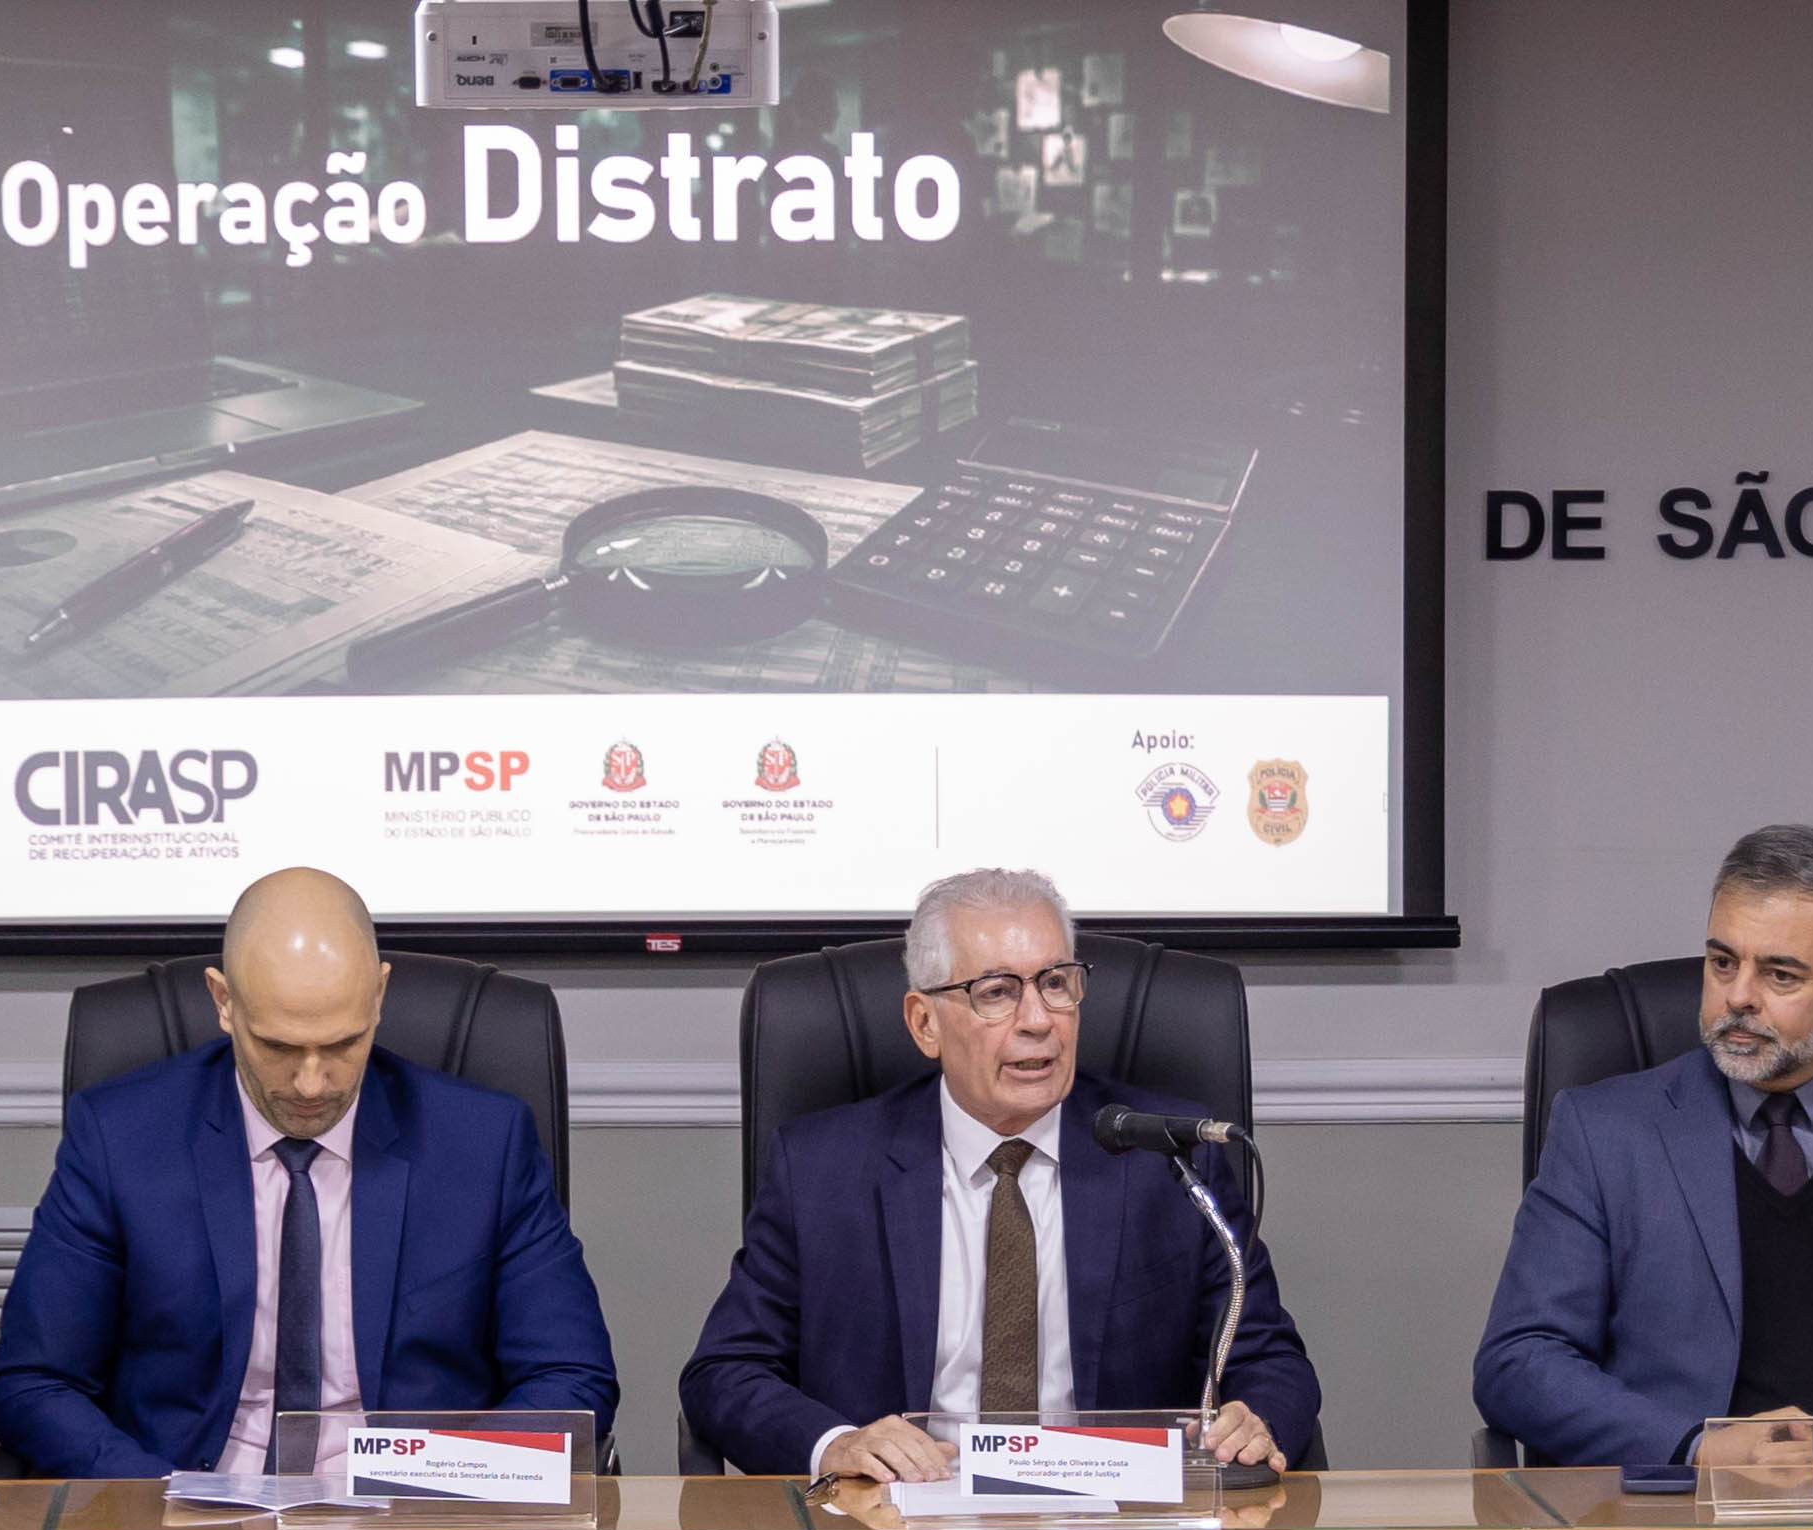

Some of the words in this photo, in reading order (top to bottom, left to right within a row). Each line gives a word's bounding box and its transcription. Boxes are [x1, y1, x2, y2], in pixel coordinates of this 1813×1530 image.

[0, 150, 427, 269] Operação
[463, 124, 960, 243] Distrato
[1485, 489, 1606, 561] DE
[1131, 728, 1195, 754] Apoio:
[385, 751, 531, 792] MPSP
[15, 749, 258, 826] CIRASP
[87, 832, 239, 845] INTERINSTITUCIONAL
[29, 848, 47, 860] DE
[53, 846, 160, 861] RECUPERAÇÃO
[166, 847, 184, 859] DE
[189, 846, 239, 859] ATIVOS
[354, 1438, 426, 1455] MPSP
[972, 1435, 1038, 1452] MPSP
[426, 1459, 455, 1468] Rogério
[457, 1460, 488, 1469] Campos
[1032, 1459, 1055, 1467] Sérgio
[1107, 1459, 1129, 1467] Costa
[369, 1469, 408, 1477] secretário
[460, 1471, 498, 1480] Secretaria
[500, 1472, 510, 1480] da
[511, 1473, 543, 1481] Fazenda
[1017, 1470, 1082, 1478] procurador-geral
[1094, 1471, 1121, 1479] Justiça
